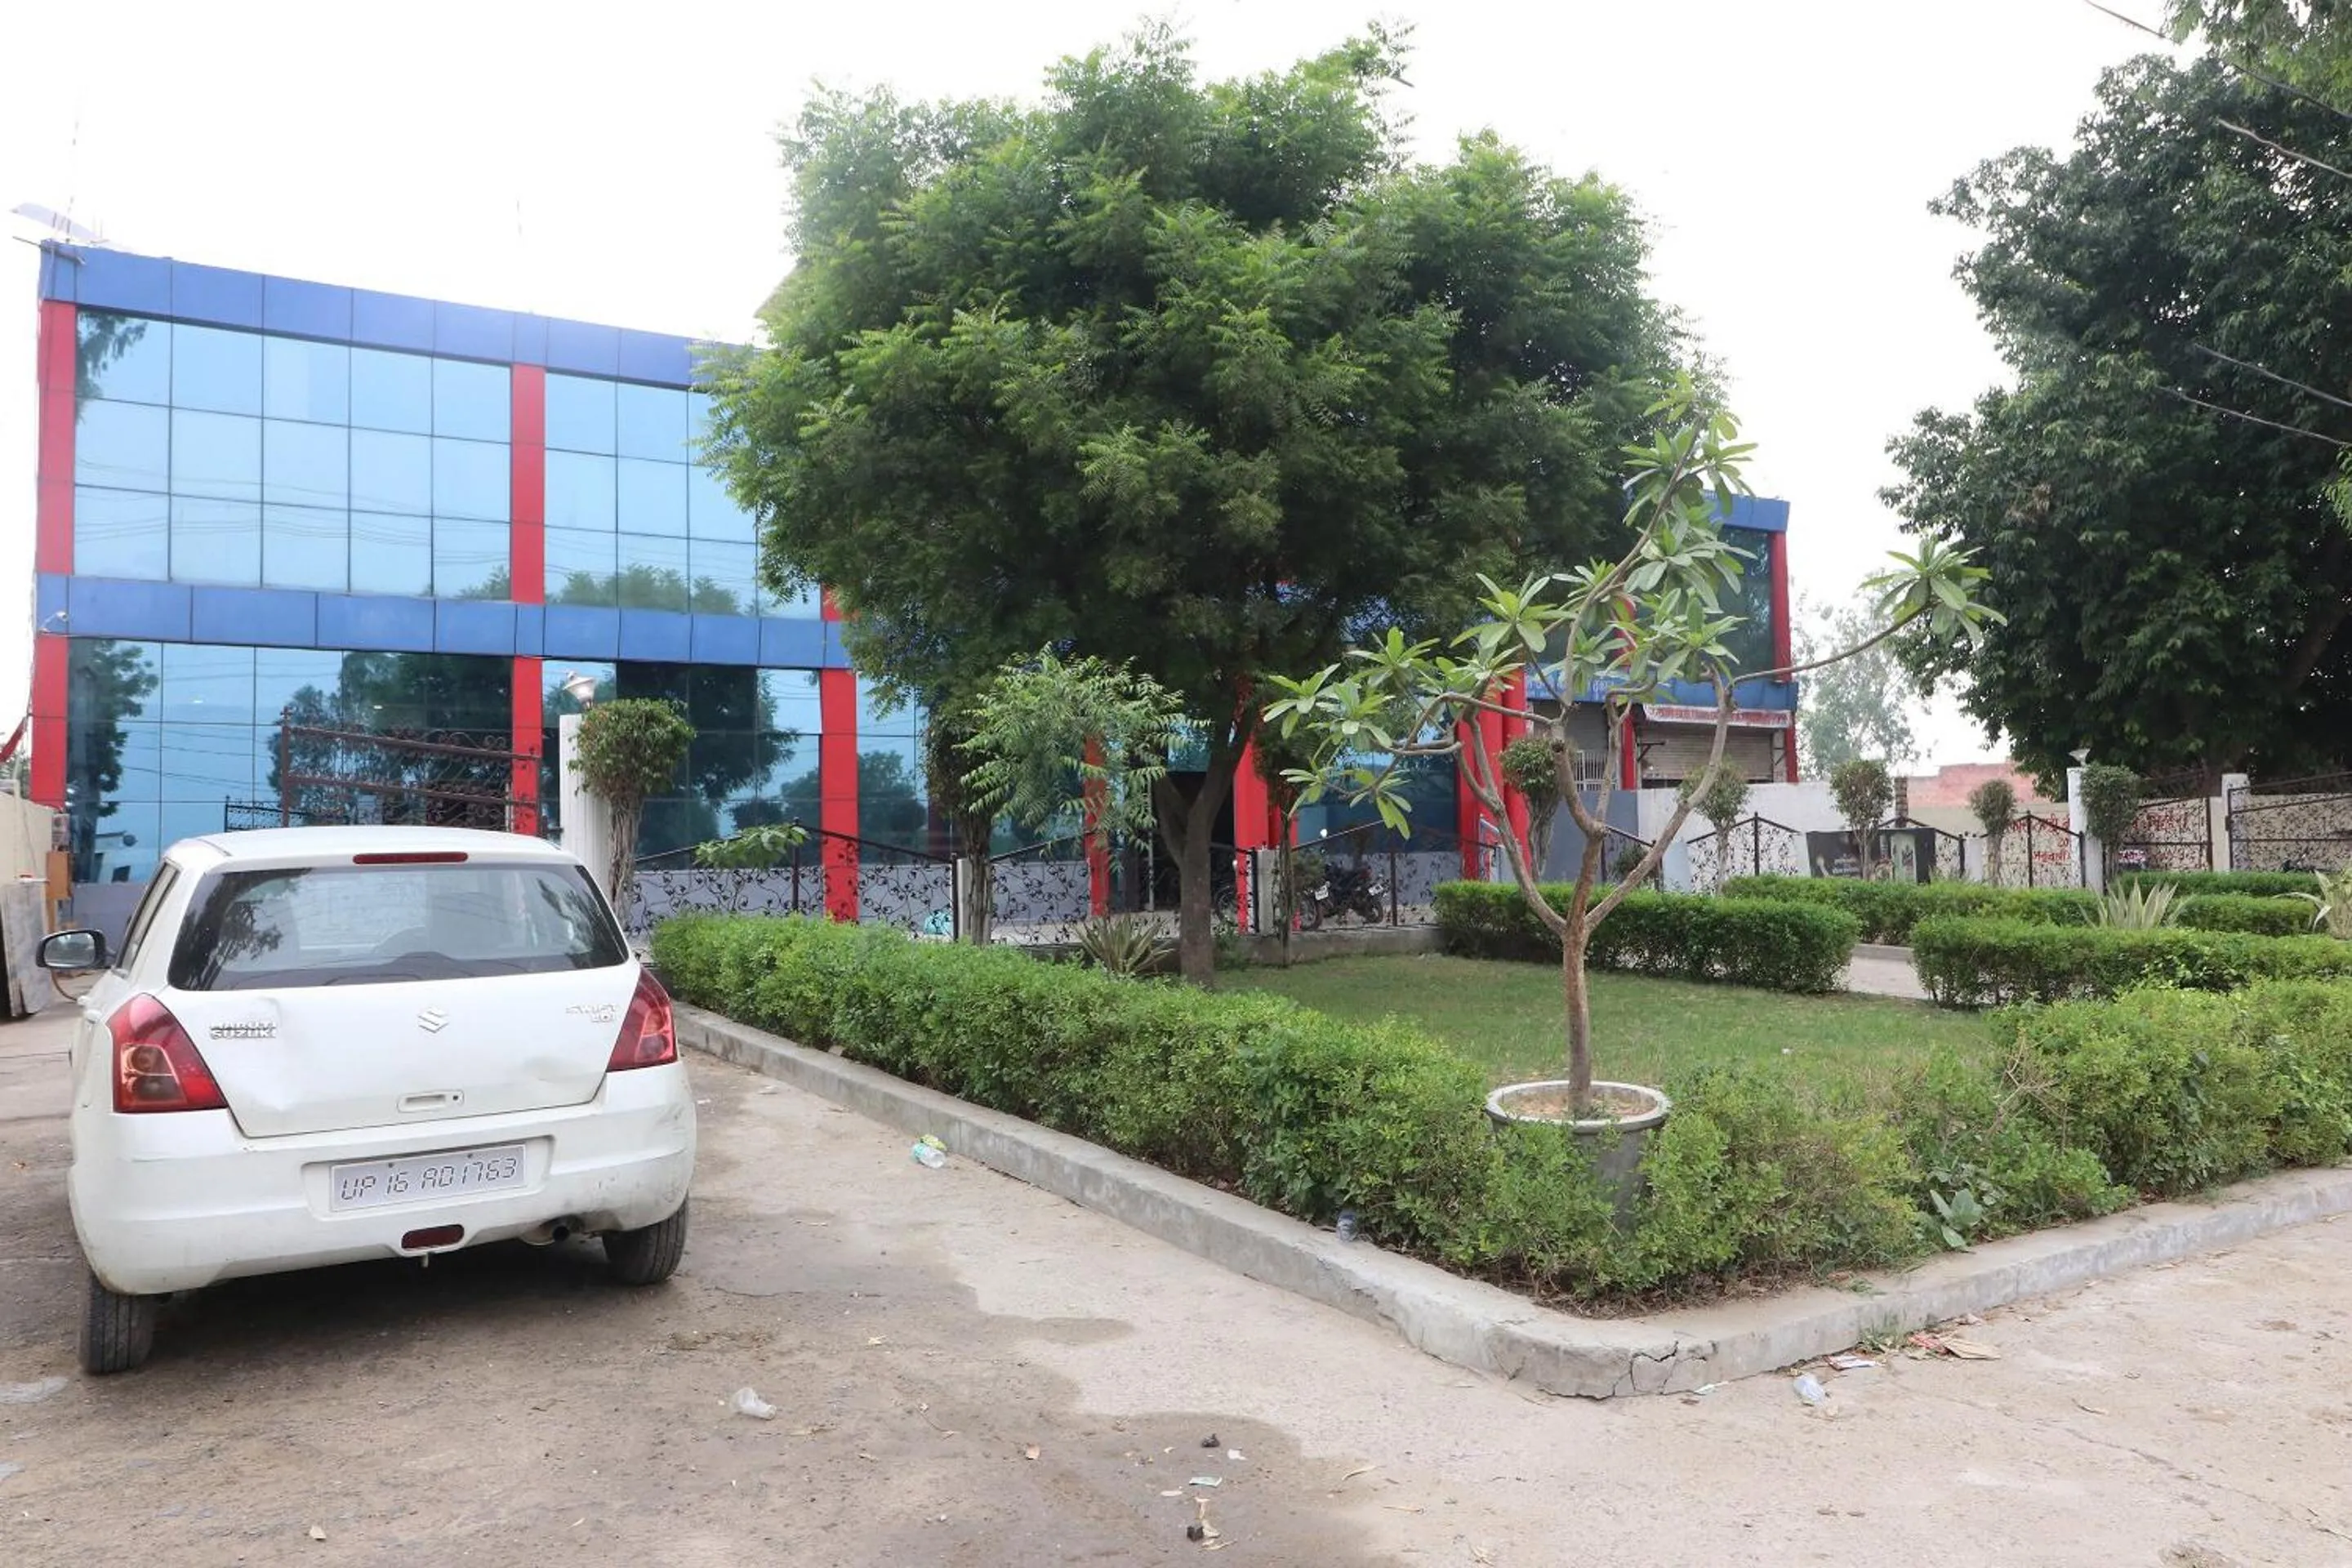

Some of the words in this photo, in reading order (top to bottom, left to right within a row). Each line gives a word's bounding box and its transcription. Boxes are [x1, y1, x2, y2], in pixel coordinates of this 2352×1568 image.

[211, 1029, 277, 1040] SUZUKI
[341, 1175, 376, 1200] UP
[386, 1171, 408, 1195] 16
